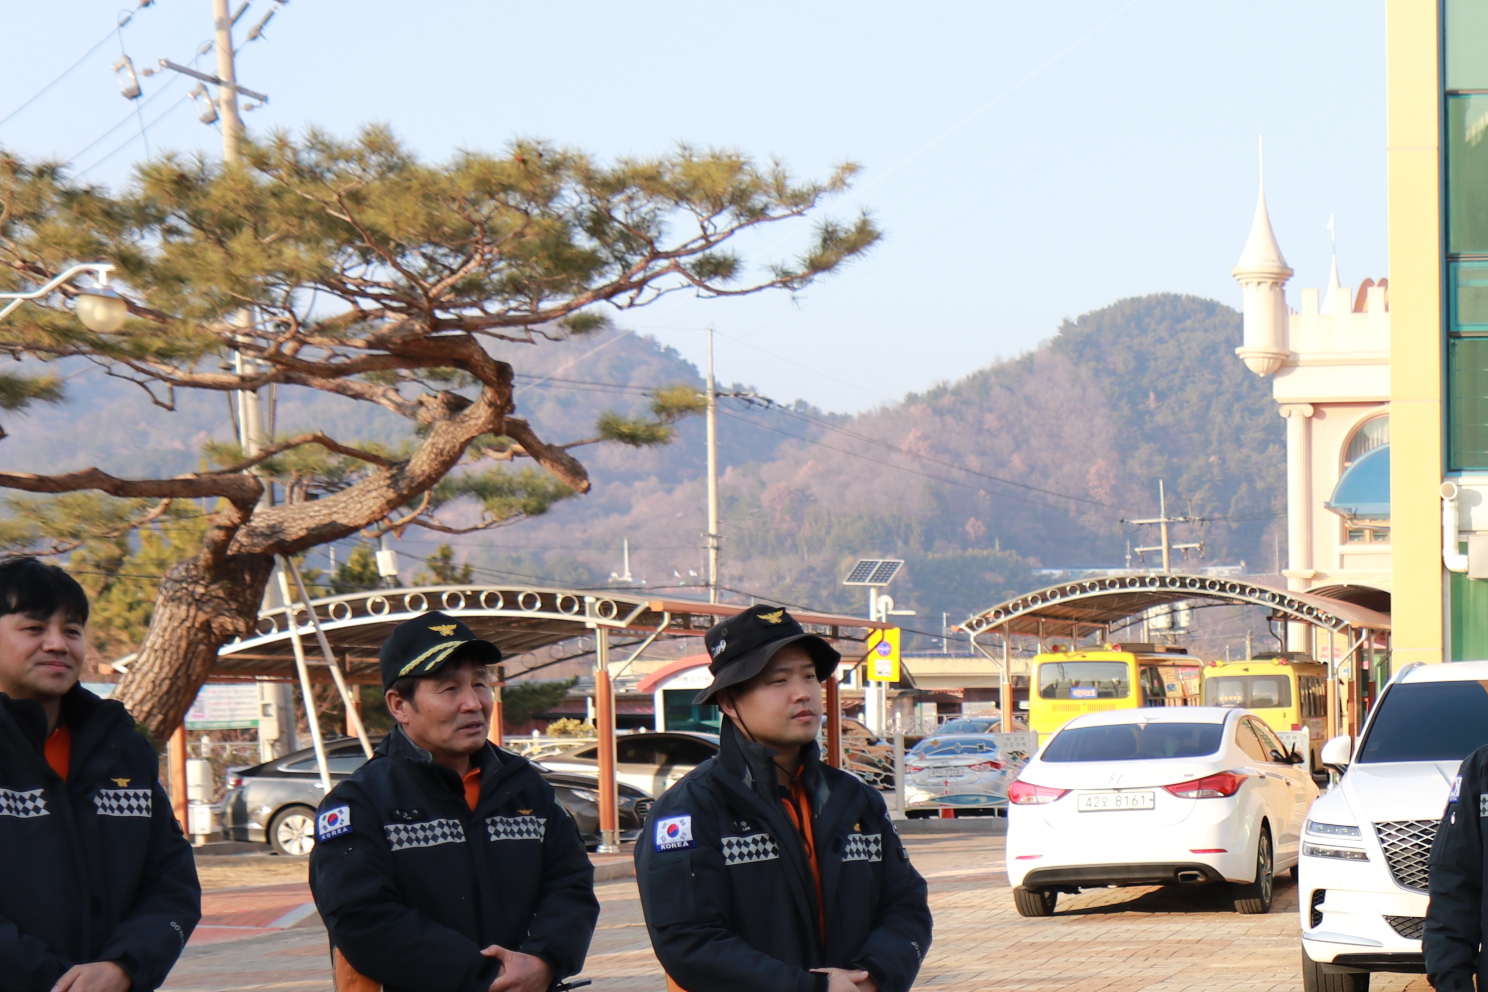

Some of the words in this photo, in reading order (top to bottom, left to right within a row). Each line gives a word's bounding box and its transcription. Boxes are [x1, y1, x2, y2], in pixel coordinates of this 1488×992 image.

[1085, 796, 1108, 808] 42오
[1115, 794, 1145, 806] 8161
[321, 827, 349, 840] KOREA
[660, 840, 690, 851] KOREA
